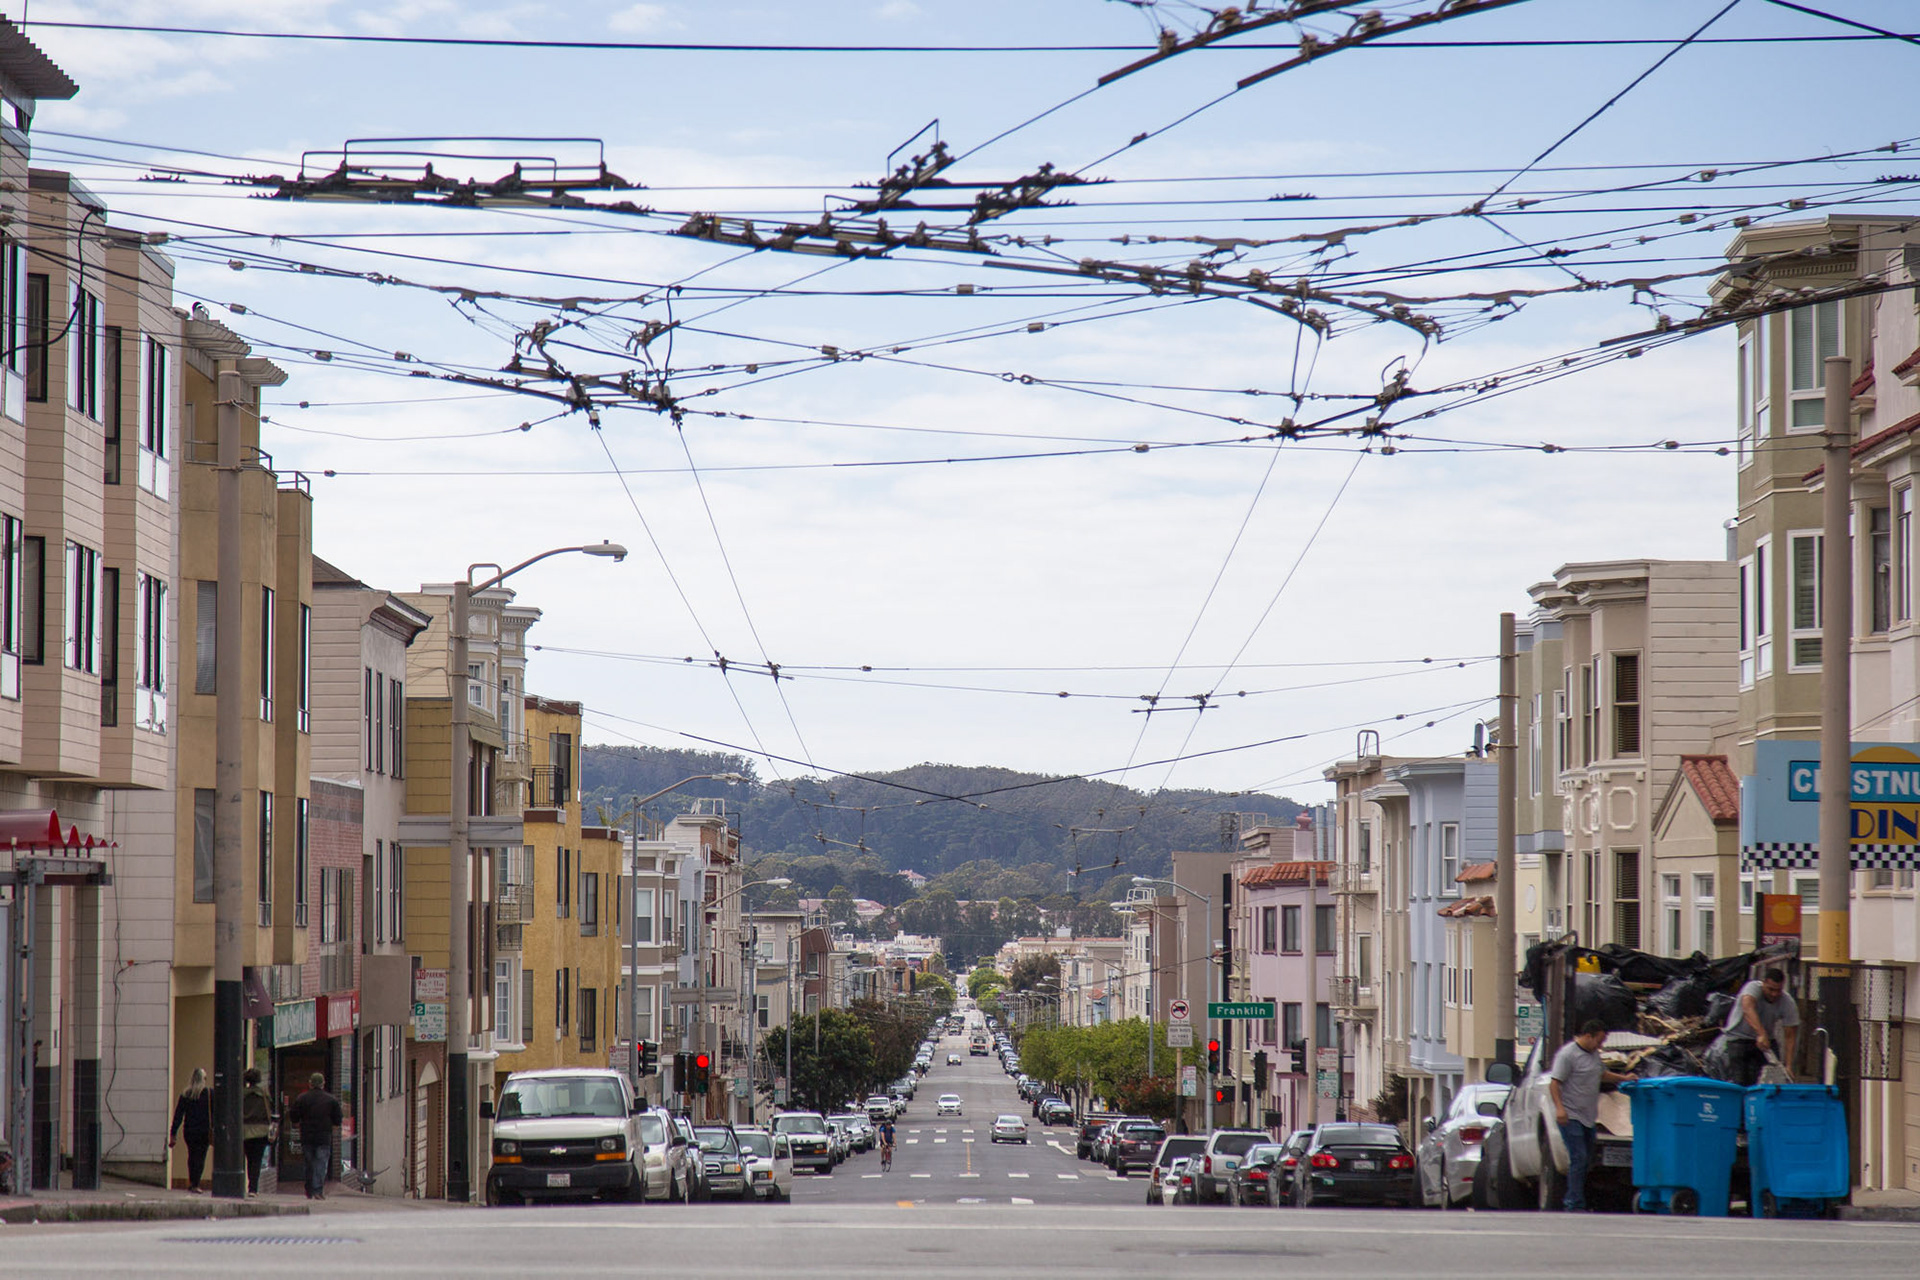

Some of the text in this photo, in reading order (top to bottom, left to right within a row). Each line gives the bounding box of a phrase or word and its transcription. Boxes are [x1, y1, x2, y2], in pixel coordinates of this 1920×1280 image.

[1794, 768, 1920, 795] CSTN
[416, 1005, 424, 1015] 2
[1216, 1006, 1266, 1015] Franklin
